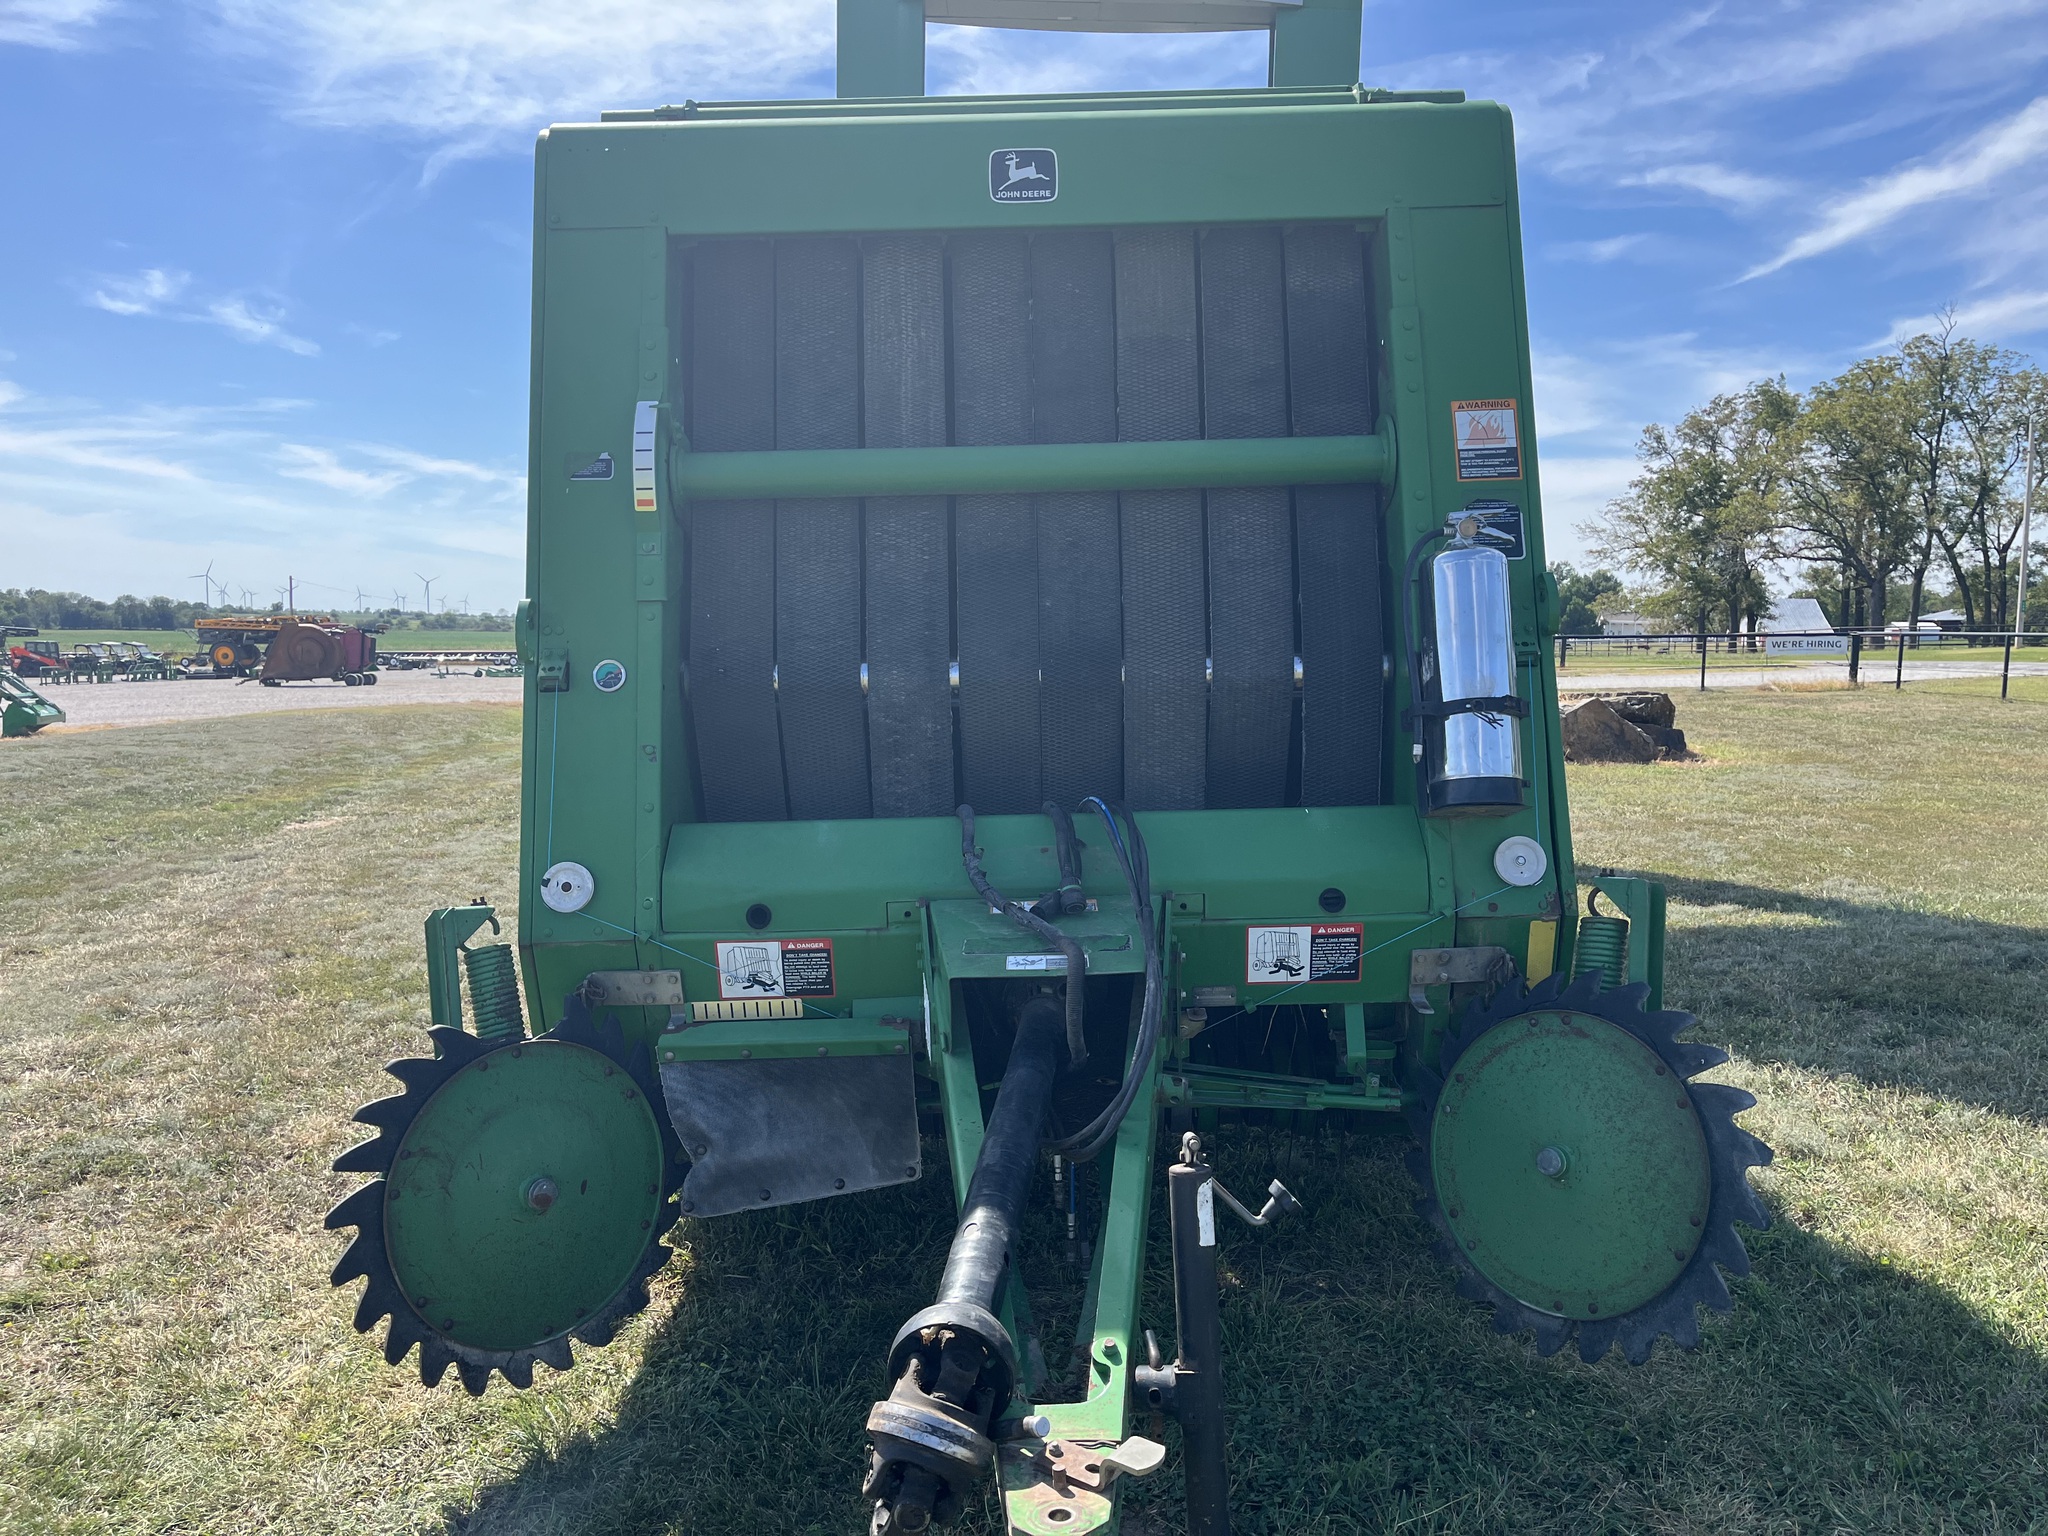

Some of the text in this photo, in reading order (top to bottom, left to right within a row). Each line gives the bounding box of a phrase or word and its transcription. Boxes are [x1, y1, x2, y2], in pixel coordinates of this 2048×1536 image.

[996, 190, 1051, 198] JOHN DEERE
[1465, 400, 1511, 409] WARNING
[1771, 640, 1842, 649] WE'RE HIRING
